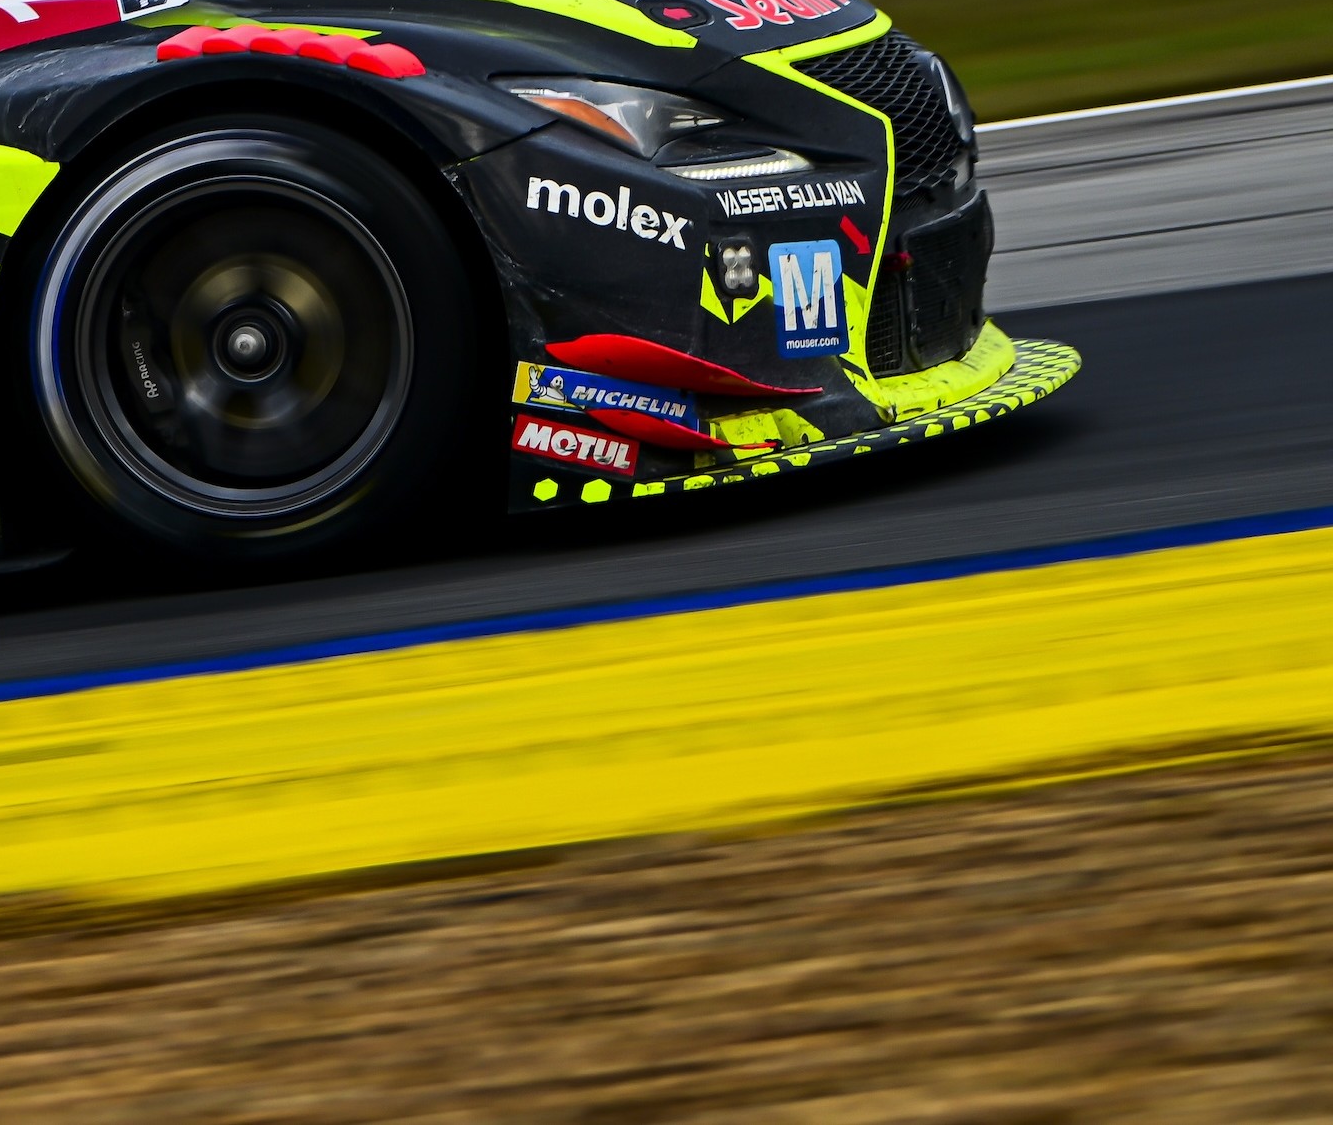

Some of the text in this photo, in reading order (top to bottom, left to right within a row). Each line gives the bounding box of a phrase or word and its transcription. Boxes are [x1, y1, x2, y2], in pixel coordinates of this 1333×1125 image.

[526, 176, 693, 250] molex
[716, 180, 866, 218] VASSER SULLIVAN
[779, 252, 837, 332] M
[786, 336, 840, 350] mouser.com
[572, 386, 686, 418] MICHELIN
[517, 422, 631, 469] MOTUL
